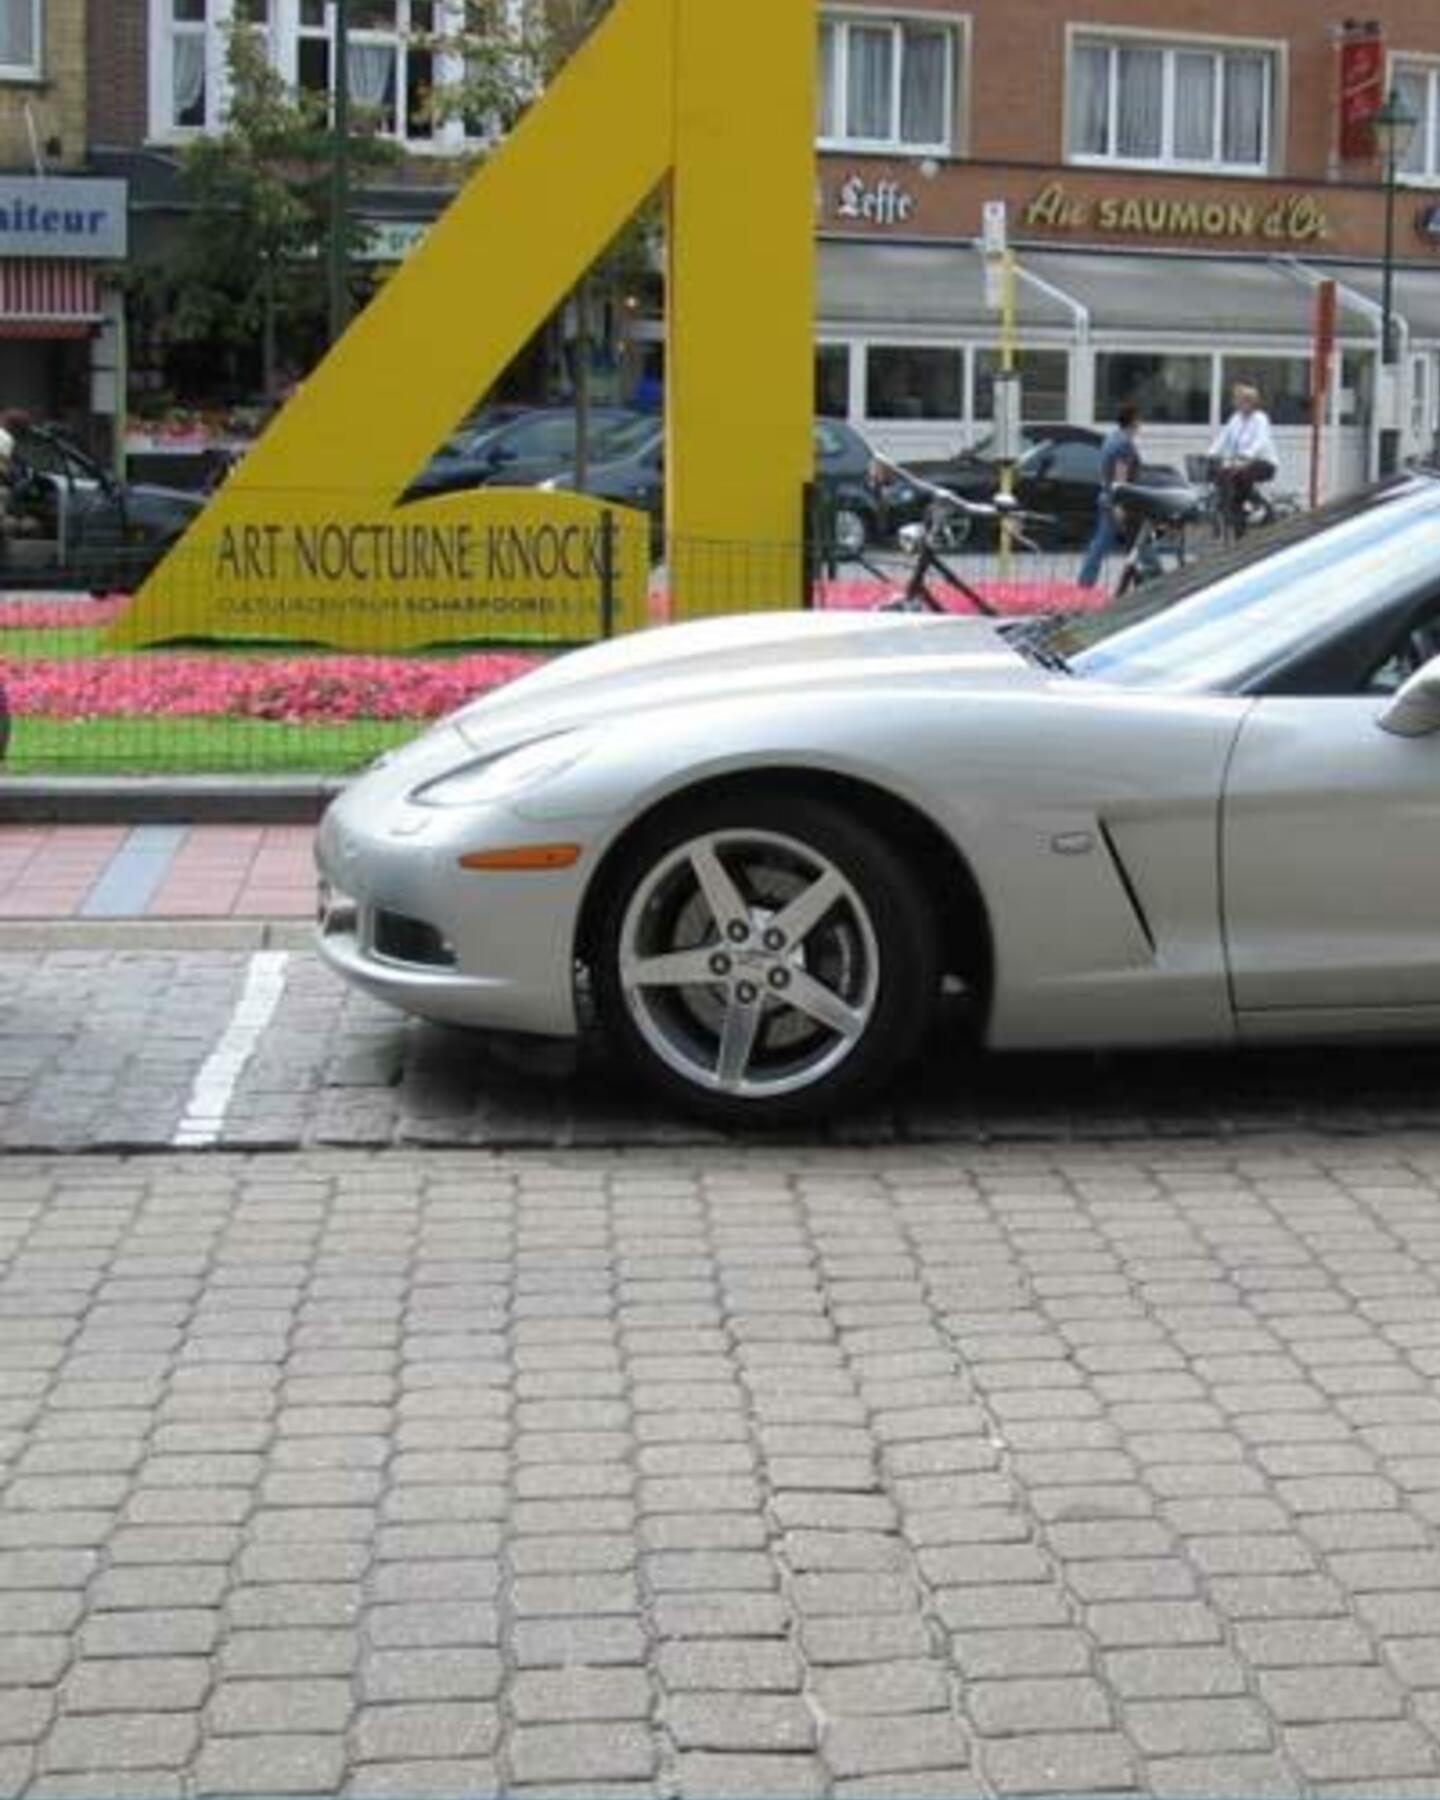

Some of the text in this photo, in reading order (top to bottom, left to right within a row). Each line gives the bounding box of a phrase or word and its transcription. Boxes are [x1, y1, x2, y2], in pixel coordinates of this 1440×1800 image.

[837, 176, 913, 224] Leffe
[1099, 198, 1254, 235] SAUMON
[215, 523, 283, 580] ART
[294, 523, 472, 580] NOCTURNE
